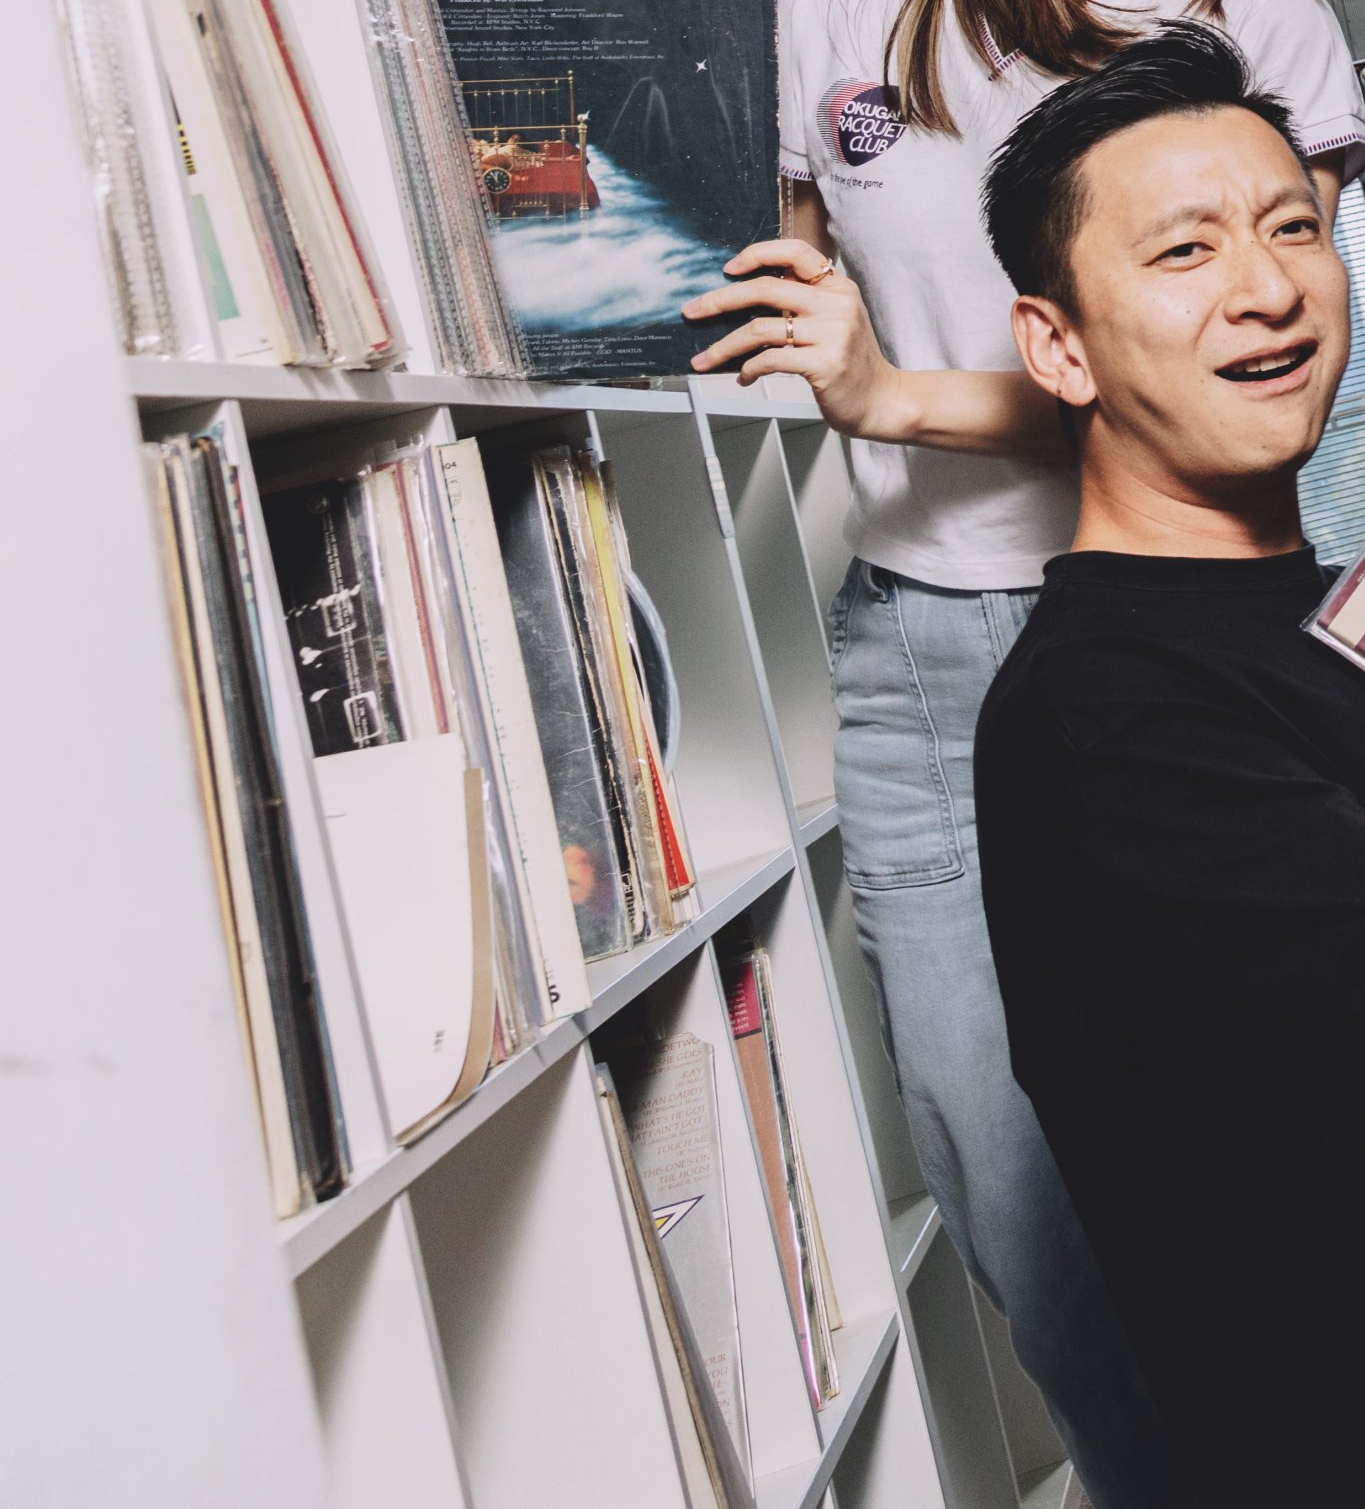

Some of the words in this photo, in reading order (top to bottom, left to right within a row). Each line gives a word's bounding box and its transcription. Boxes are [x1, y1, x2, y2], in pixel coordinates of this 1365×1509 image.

[839, 115, 907, 139] RACQUET
[849, 135, 889, 154] CLUB
[864, 178, 884, 189] game
[674, 1046, 704, 1062] GOES
[668, 1084, 706, 1102] DADDY
[655, 1138, 693, 1155] TOUCH
[657, 1173, 678, 1185] THE
[677, 1163, 713, 1179] HOUSE
